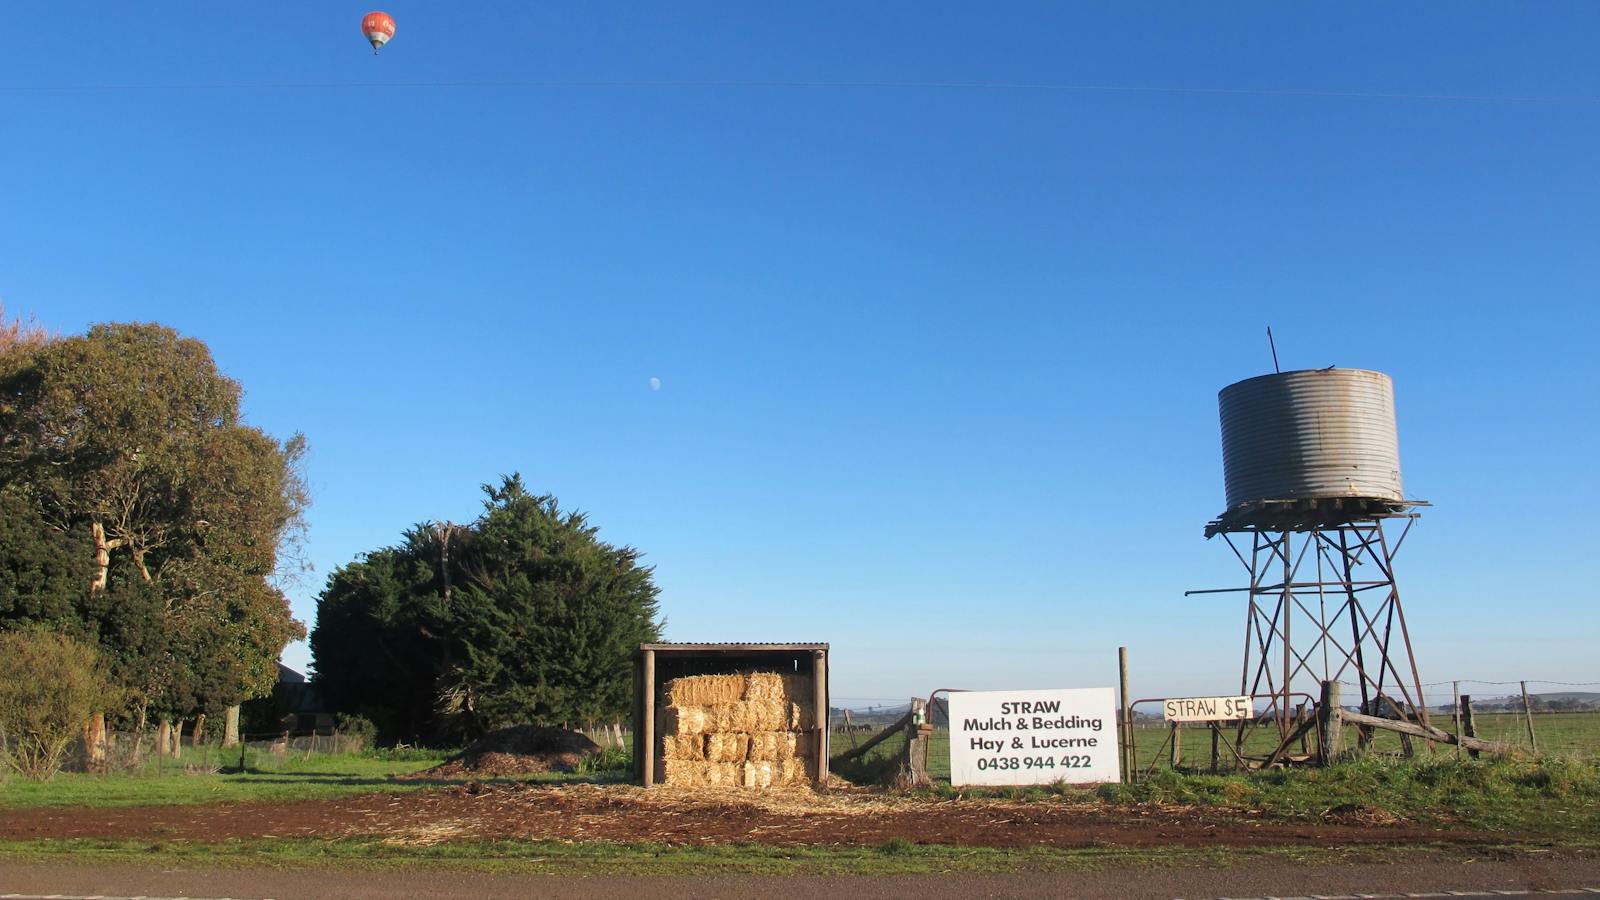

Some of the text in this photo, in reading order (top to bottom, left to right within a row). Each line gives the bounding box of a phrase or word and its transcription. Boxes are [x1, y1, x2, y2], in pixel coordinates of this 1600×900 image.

[1001, 701, 1061, 714] STRAW
[1166, 698, 1248, 718] STRAW $5
[963, 716, 1102, 731] Mulch & Bedding
[970, 736, 1098, 752] Hay & Lucerne
[977, 755, 1092, 770] 0438 944 422
